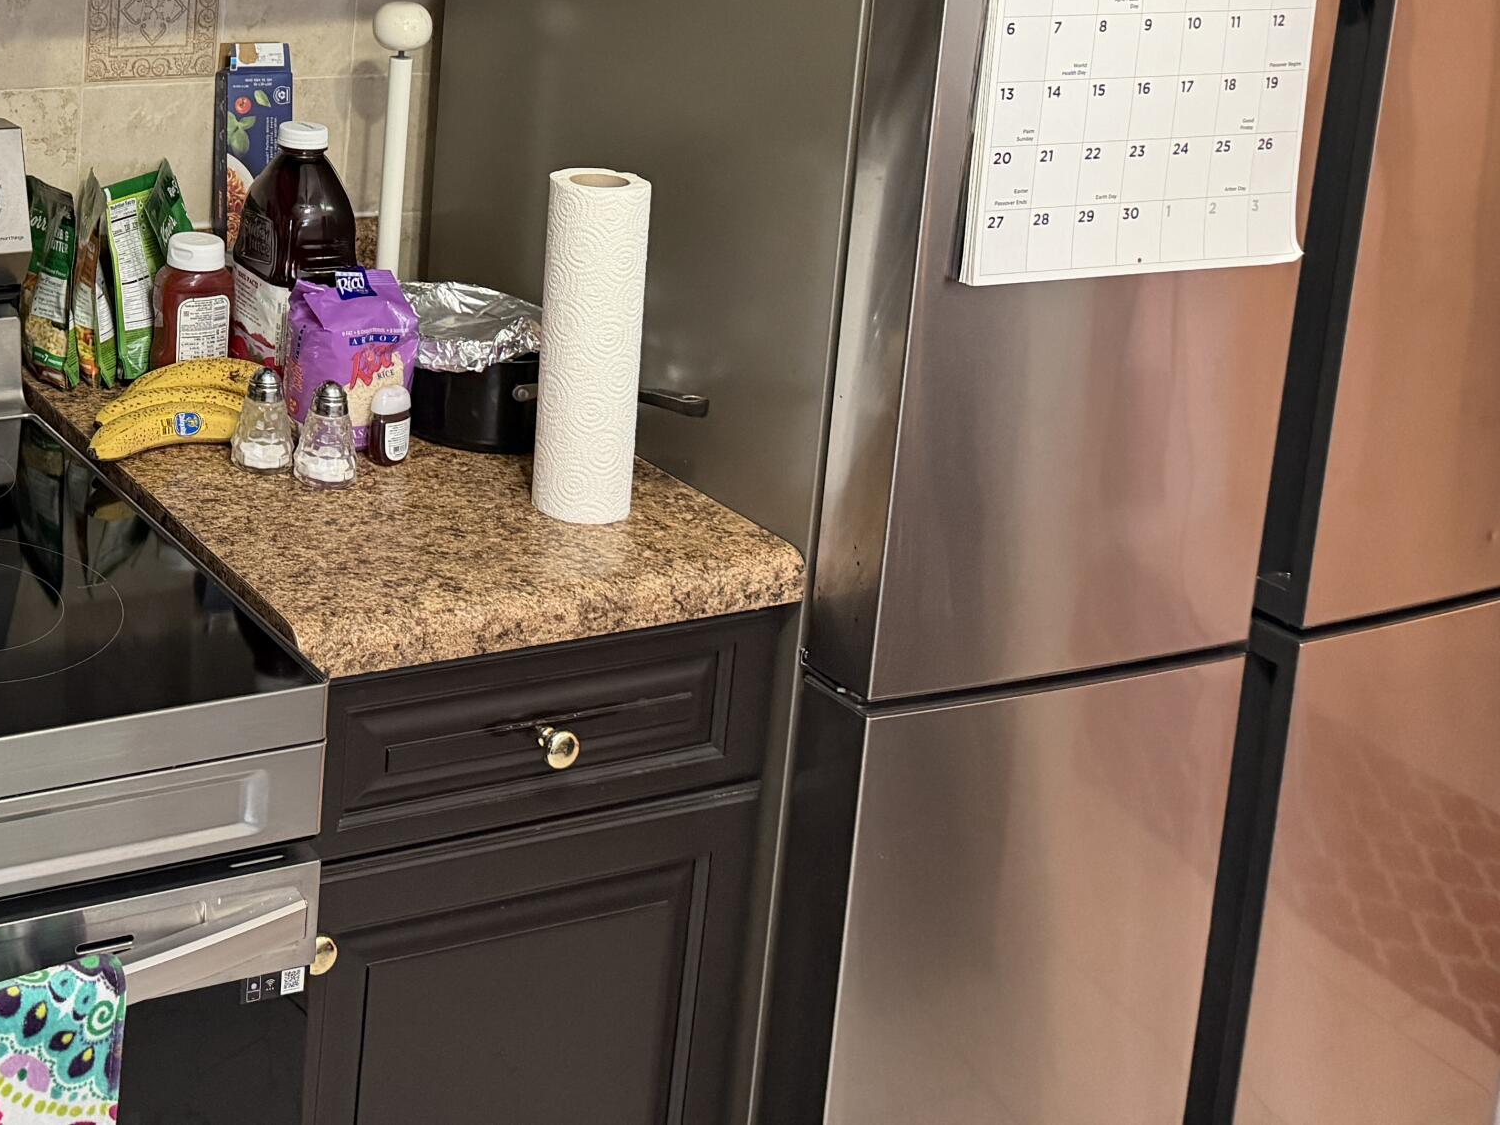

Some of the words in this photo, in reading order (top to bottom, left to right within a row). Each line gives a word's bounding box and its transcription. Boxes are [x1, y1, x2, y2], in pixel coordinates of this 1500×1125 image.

[1007, 22, 1015, 35] 6
[1054, 22, 1062, 33] 7
[1099, 20, 1107, 32] 8
[1144, 19, 1152, 31] 9
[1188, 17, 1202, 29] 10
[1231, 16, 1241, 27] 11
[1273, 14, 1285, 26] 12
[1001, 88, 1014, 100] 13
[1047, 86, 1061, 98] 14
[1092, 84, 1105, 97] 15
[1137, 82, 1151, 95] 16
[1181, 80, 1194, 92] 17
[1224, 79, 1236, 91] 18
[1266, 77, 1278, 89] 19
[993, 152, 1012, 165] 20
[1040, 150, 1053, 162] 21
[1084, 148, 1101, 160] 22
[1129, 145, 1145, 157] 23
[1172, 143, 1188, 155] 24
[1215, 140, 1230, 152] 25
[1258, 138, 1272, 150] 26
[987, 216, 1004, 229] 27
[1033, 213, 1049, 225] 28
[1078, 210, 1094, 222] 29
[1122, 207, 1139, 219] 30
[1166, 205, 1171, 217] 1
[1209, 202, 1216, 214] 2
[1252, 200, 1259, 211] 3
[352, 335, 398, 345] ARROZ
[377, 370, 395, 379] RICE
